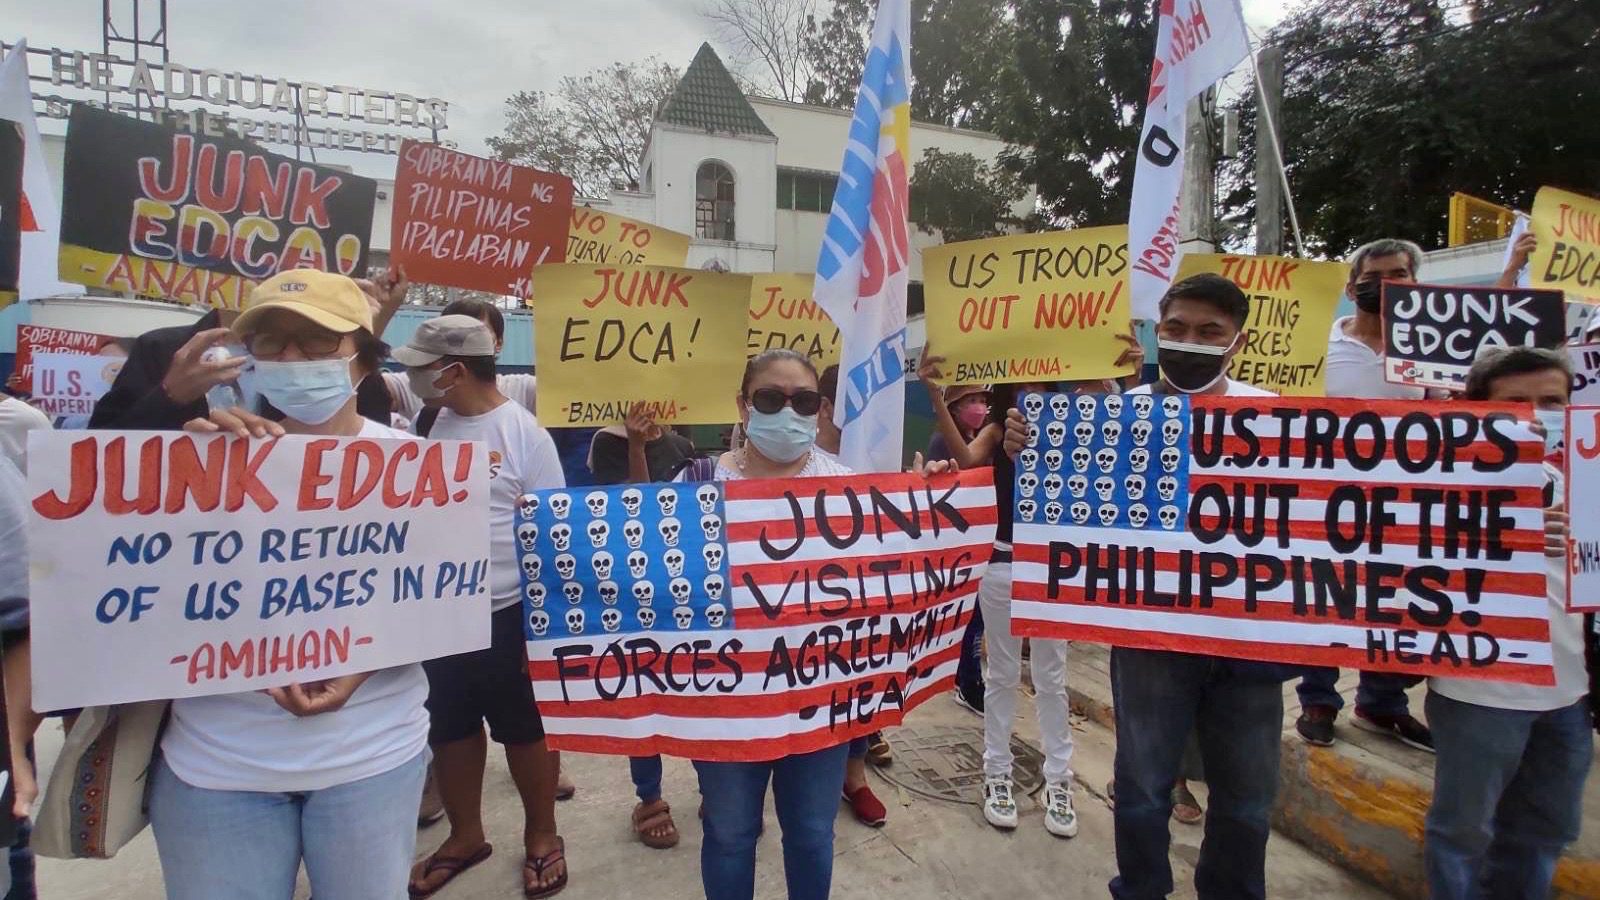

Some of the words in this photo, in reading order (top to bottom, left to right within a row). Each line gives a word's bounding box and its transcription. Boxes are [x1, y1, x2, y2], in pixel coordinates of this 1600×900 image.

[52, 48, 449, 130] HEADQUARTERS
[236, 117, 459, 154] PHILIPPI
[138, 134, 343, 229] JUNK
[404, 144, 512, 193] SOBERANYA
[531, 182, 554, 204] NG
[409, 182, 532, 231] PILIPINAS
[1552, 204, 1600, 244] JUN
[129, 197, 361, 279] EDCA!
[567, 235, 612, 265] TURN
[618, 222, 652, 249] TO
[280, 283, 308, 292] NEW
[584, 268, 693, 309] JUNK
[948, 251, 1000, 289] US
[1012, 243, 1128, 285] TROOPS
[1221, 257, 1300, 291] JUNK
[958, 294, 1020, 334] OUT
[1034, 279, 1123, 330] NOW!
[1245, 295, 1301, 329] TING
[1394, 290, 1540, 327] JUNK
[20, 326, 98, 349] SOBERANYA
[560, 317, 700, 365] EDCA!
[1243, 328, 1293, 357] RCES
[42, 369, 91, 397] U.S.
[38, 399, 91, 415] IMPERI
[32, 434, 280, 521] JUNK
[296, 438, 474, 512] EDCA!
[107, 532, 172, 567] NO
[187, 529, 244, 566] TO
[258, 520, 410, 563] RETURN
[758, 480, 971, 562] JUNK
[1188, 483, 1300, 550] OUT
[1324, 484, 1399, 554] OF
[1412, 487, 1517, 561] THE
[95, 586, 160, 625] OF
[184, 580, 240, 621] US
[259, 567, 377, 620] BASES
[393, 564, 425, 605] IN
[434, 558, 488, 600] PH!
[742, 551, 972, 621] VISITING
[1047, 540, 1487, 628] PHILIPPINES!
[552, 637, 744, 706] FORCES
[762, 599, 964, 692] AGREEMENT!
